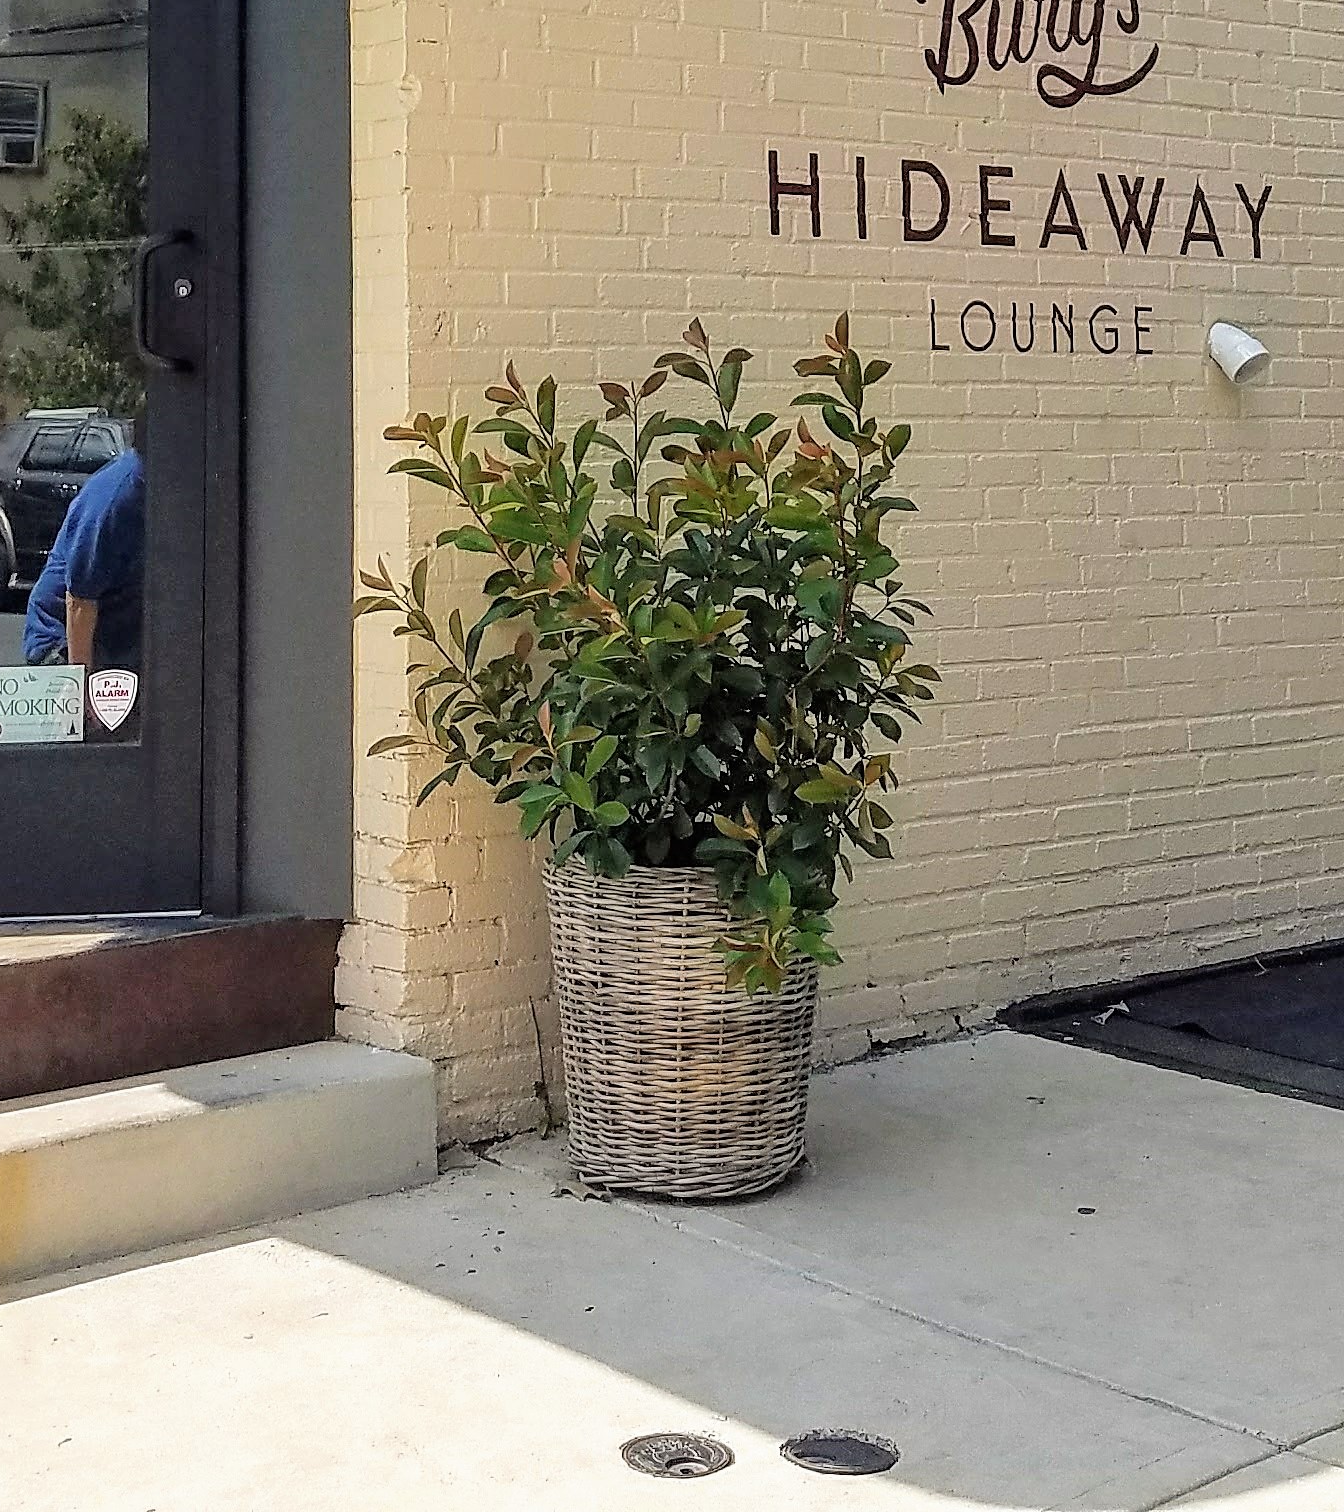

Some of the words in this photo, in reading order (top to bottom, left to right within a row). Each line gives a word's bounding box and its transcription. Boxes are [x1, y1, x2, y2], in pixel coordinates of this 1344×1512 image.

[768, 150, 1272, 258] HIDEAWAY
[930, 299, 1154, 354] LOUNGE
[96, 689, 129, 698] ALARM
